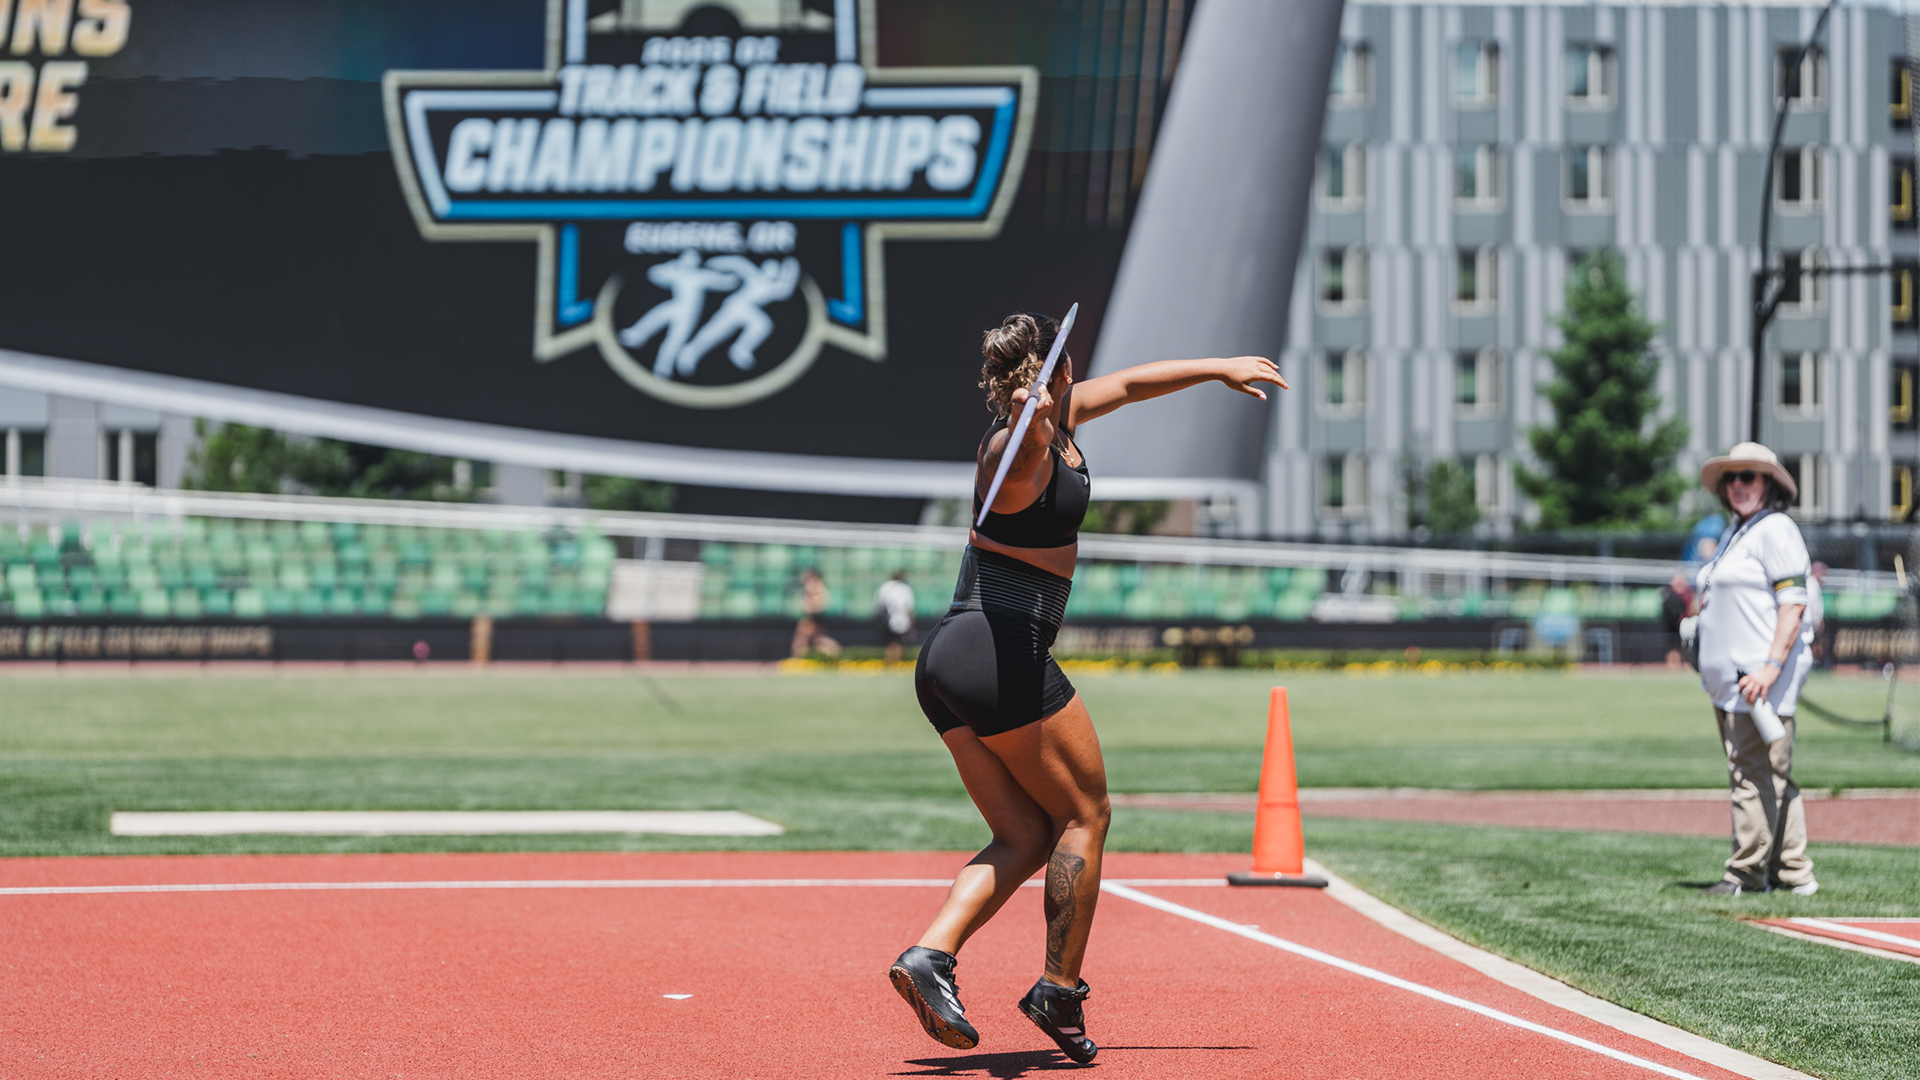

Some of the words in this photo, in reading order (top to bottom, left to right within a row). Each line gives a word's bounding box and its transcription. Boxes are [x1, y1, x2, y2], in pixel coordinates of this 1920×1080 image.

[0, 0, 131, 57] NS
[558, 64, 699, 116] TRACK
[699, 62, 740, 117] &
[740, 62, 866, 116] FIELD
[444, 115, 982, 193] CHAMPIONSHIPS
